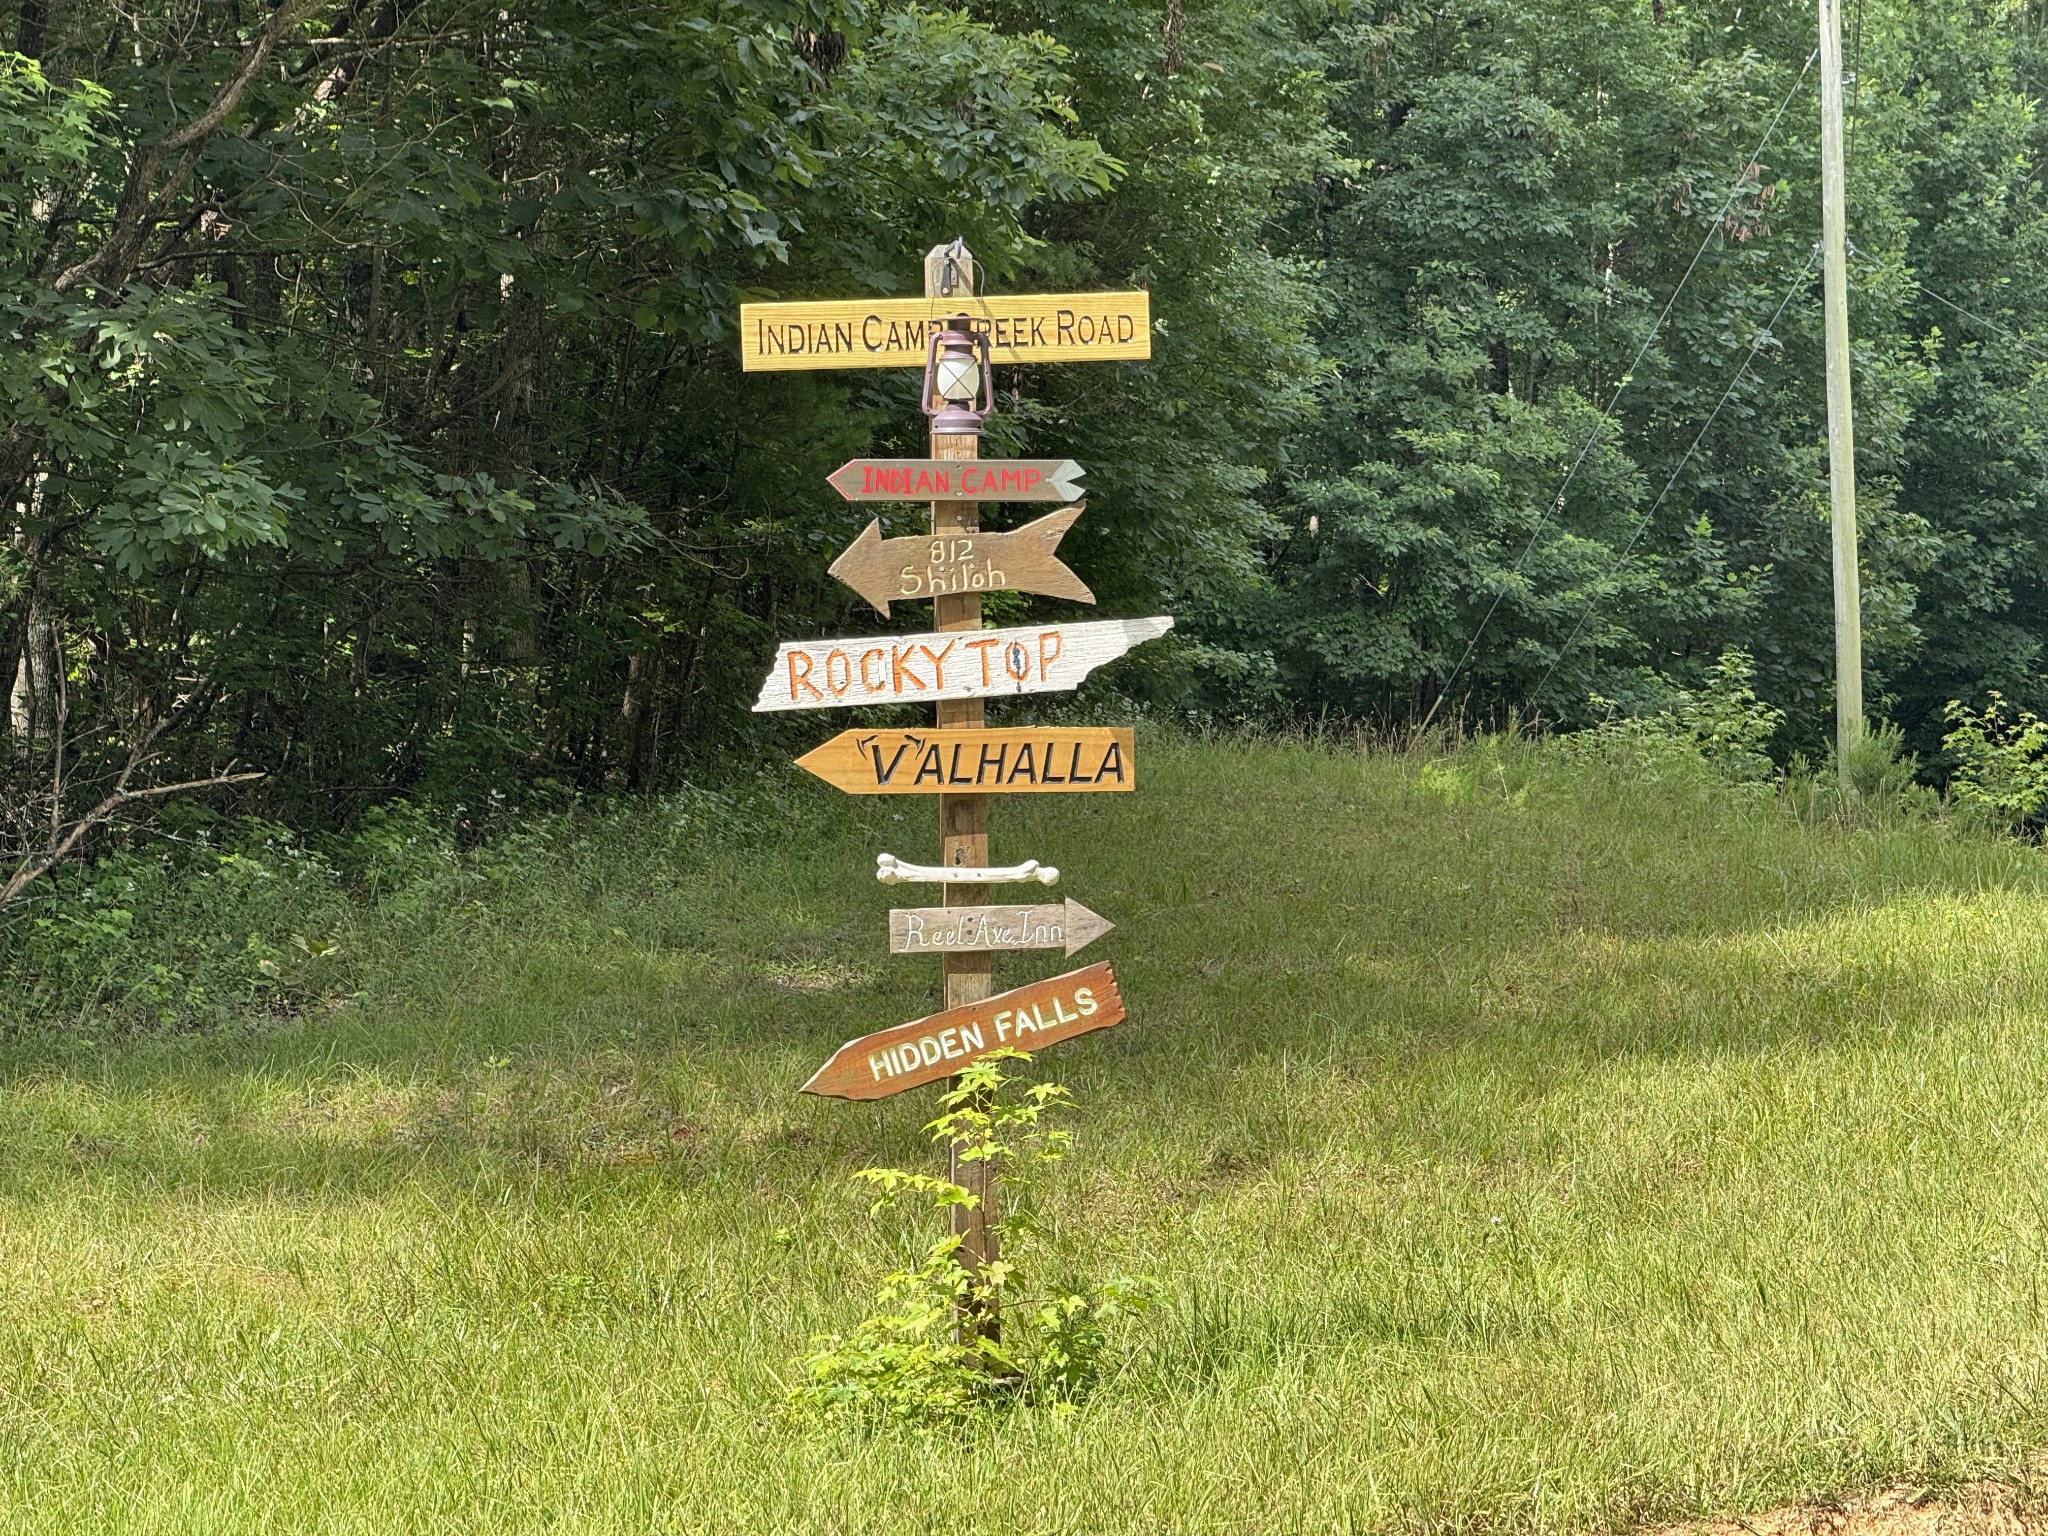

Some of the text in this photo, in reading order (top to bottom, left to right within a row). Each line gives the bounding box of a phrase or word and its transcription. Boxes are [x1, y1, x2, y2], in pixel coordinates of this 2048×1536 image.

[757, 318, 853, 356] INDIAN
[976, 316, 1049, 350] REEK
[1056, 309, 1134, 347] ROAD
[860, 465, 1042, 495] INDIAN CAMP
[929, 539, 974, 564] 812
[900, 558, 1006, 595] Shiloh
[786, 631, 1062, 702] ROCKY TOP
[898, 908, 1064, 952] Reel Axe Inn
[867, 987, 1099, 1082] HIDDEN FALLS
